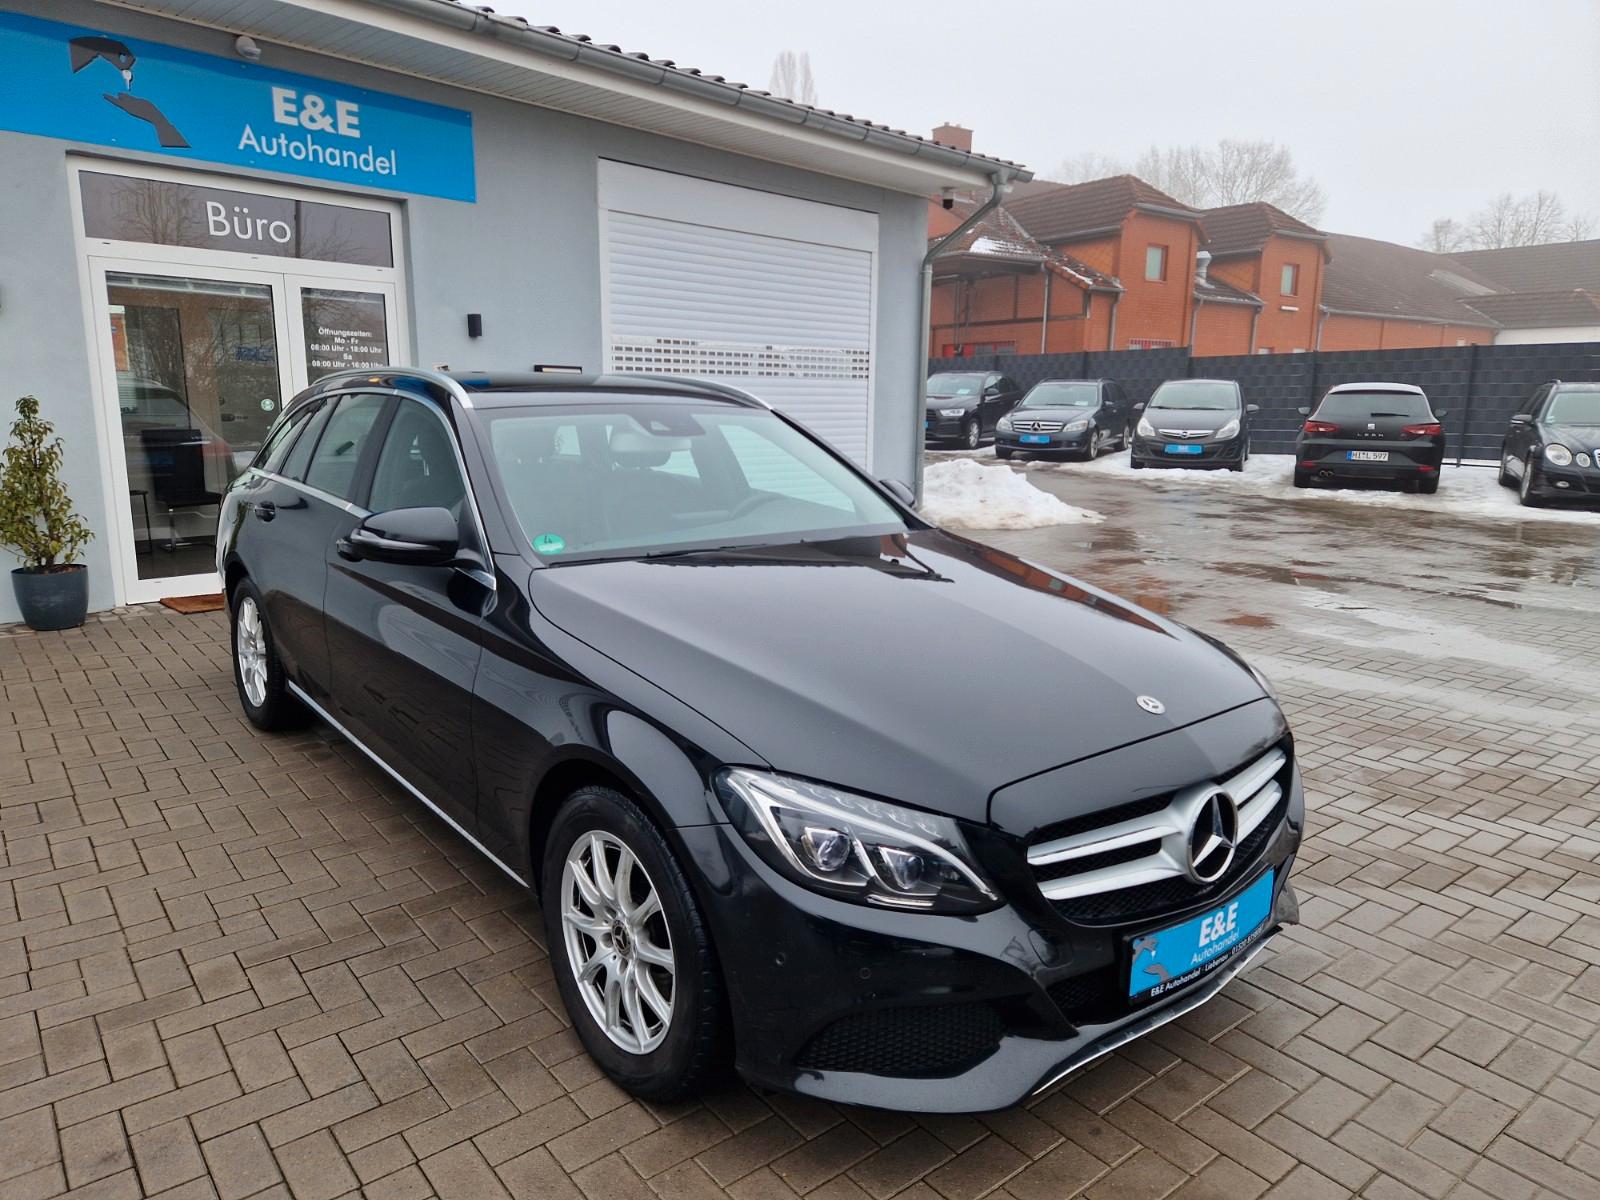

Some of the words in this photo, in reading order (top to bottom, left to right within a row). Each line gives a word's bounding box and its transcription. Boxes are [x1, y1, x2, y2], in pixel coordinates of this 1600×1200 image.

[271, 86, 361, 138] E&E
[237, 123, 397, 176] Autohandel
[206, 200, 292, 243] Büro
[318, 327, 373, 337] Öffnungszeiten:
[1190, 927, 1240, 965] Autohandel
[1199, 902, 1239, 947] E&E
[1150, 984, 1165, 997] E&E
[1165, 968, 1202, 991] Autohandel
